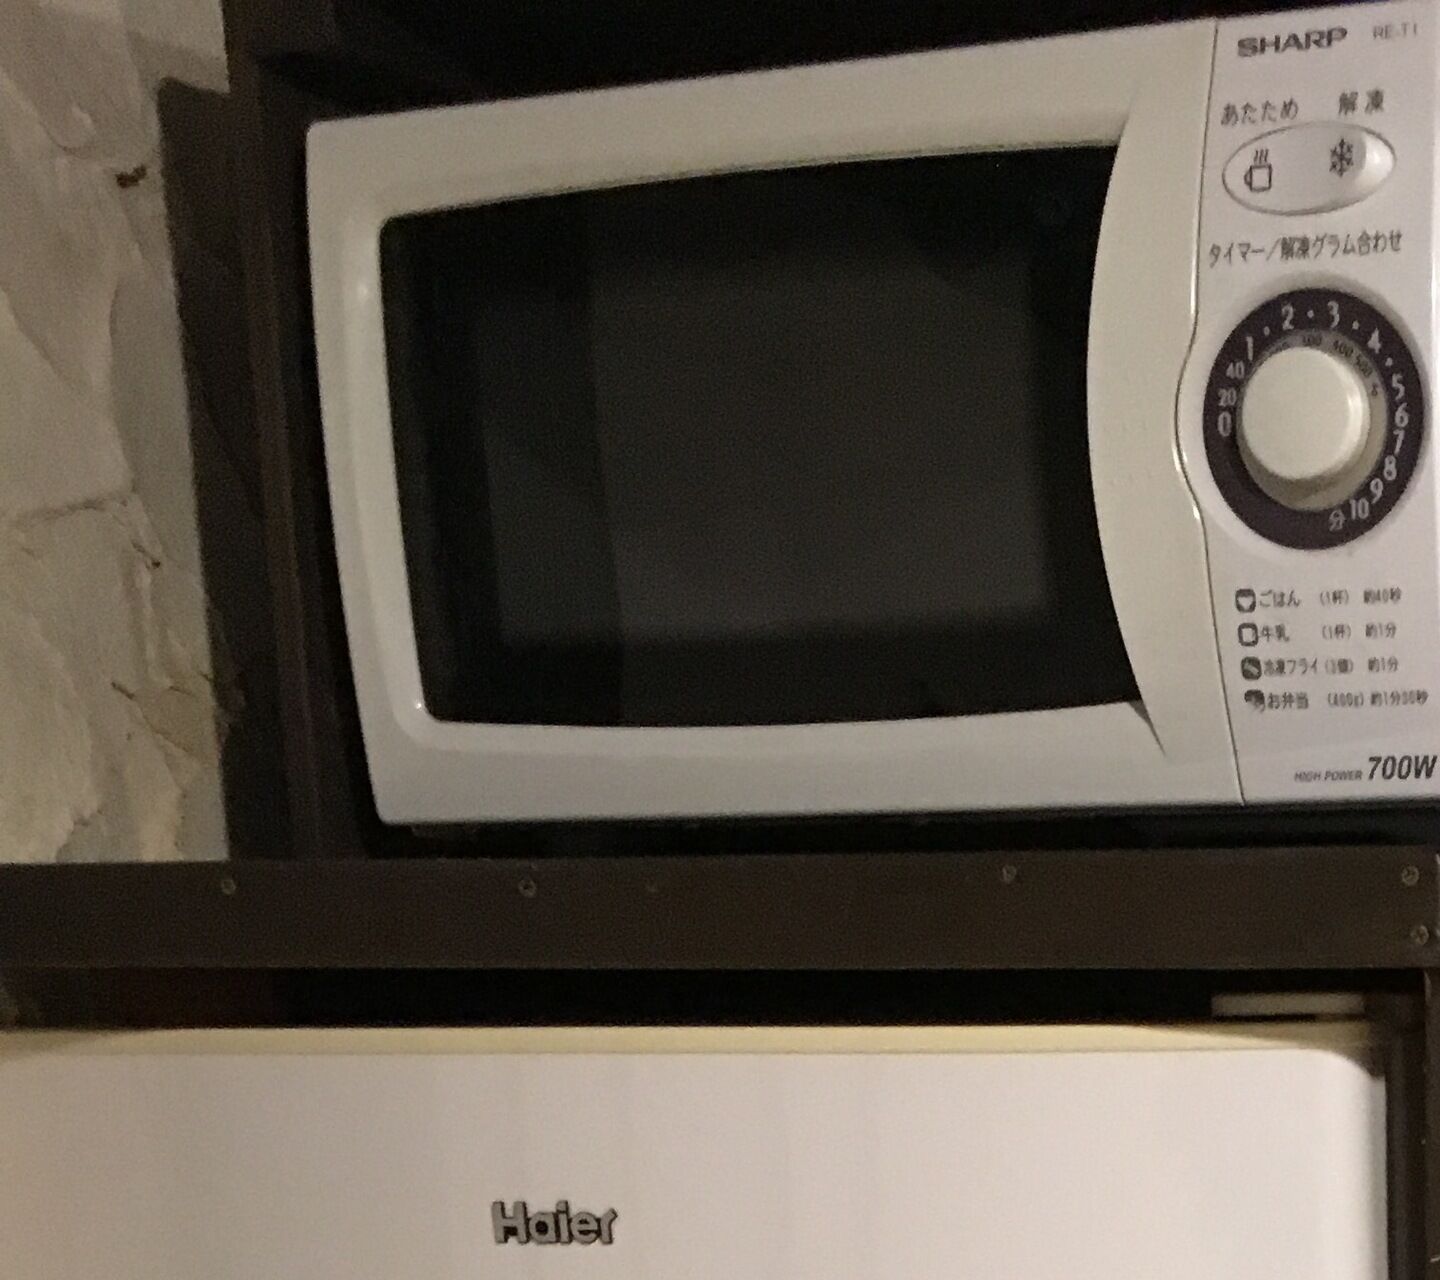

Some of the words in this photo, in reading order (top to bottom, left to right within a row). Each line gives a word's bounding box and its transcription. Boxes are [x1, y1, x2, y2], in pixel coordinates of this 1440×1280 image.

[1237, 26, 1348, 58] SHARP
[1221, 97, 1299, 126] あたため
[1281, 303, 1295, 331] 2
[1327, 301, 1340, 328] 3
[1245, 337, 1254, 361] 1
[1367, 328, 1382, 354] 4
[1226, 361, 1245, 380] 40
[1217, 388, 1237, 407] 20
[1392, 373, 1405, 400] 5
[1217, 411, 1232, 438] 0
[1394, 402, 1409, 428] 6
[1392, 430, 1405, 455] 7
[1383, 455, 1397, 481] 8
[1370, 478, 1383, 504] 9
[1350, 499, 1370, 521] 10
[1259, 589, 1301, 608] ごはん
[1261, 624, 1290, 642] 牛乳
[1365, 622, 1396, 640] 約1分
[1368, 656, 1399, 673] 約1分
[1268, 692, 1309, 710] お弁当
[1324, 769, 1363, 781] POWER
[1368, 754, 1438, 781] 700W
[491, 1200, 619, 1248] Haier
